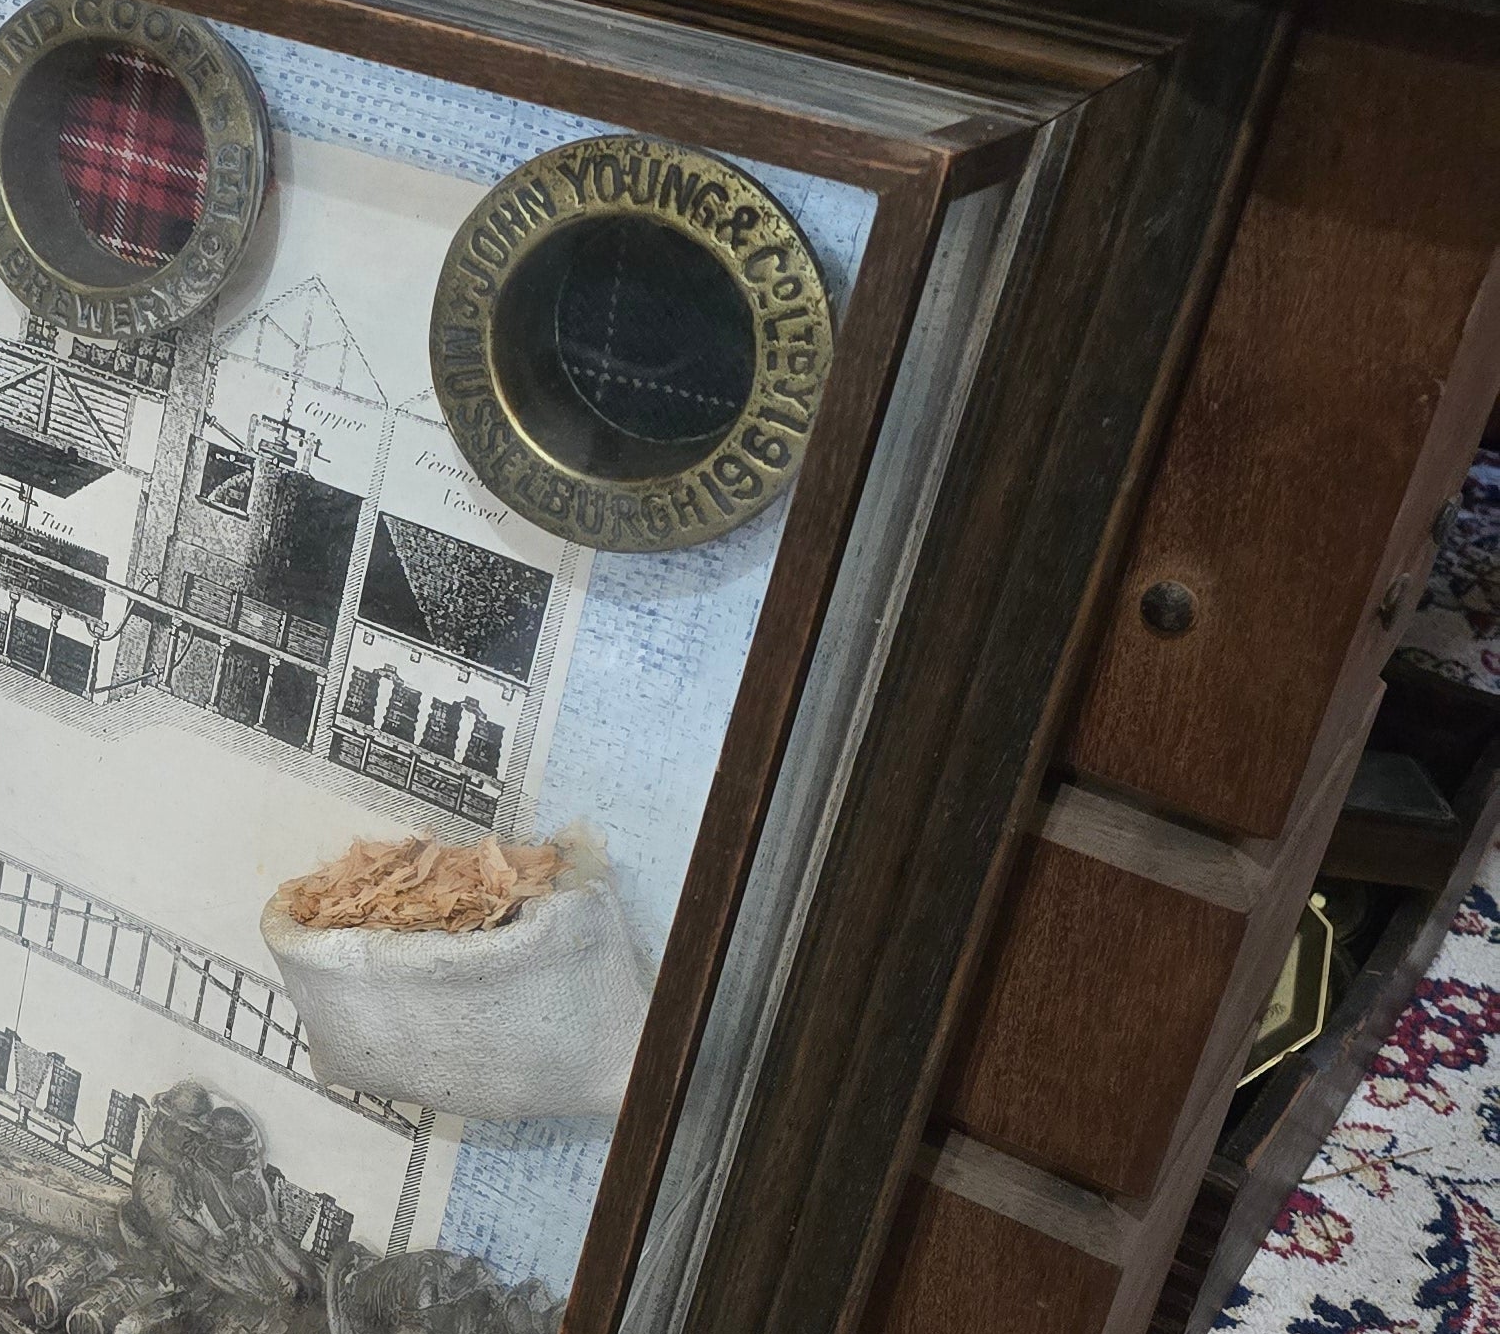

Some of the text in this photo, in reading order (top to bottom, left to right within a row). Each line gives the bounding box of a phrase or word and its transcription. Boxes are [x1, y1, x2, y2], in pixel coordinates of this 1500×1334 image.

[460, 179, 556, 295] JOHN
[561, 153, 730, 227] YOUNG
[716, 209, 760, 247] &
[1, 250, 180, 332] BREWERY
[305, 401, 367, 433] Copper
[443, 329, 809, 539] MUSSELBURGH 1961
[41, 511, 74, 535] Tun
[443, 488, 508, 525] Vessel
[61, 1201, 104, 1238] ALE
